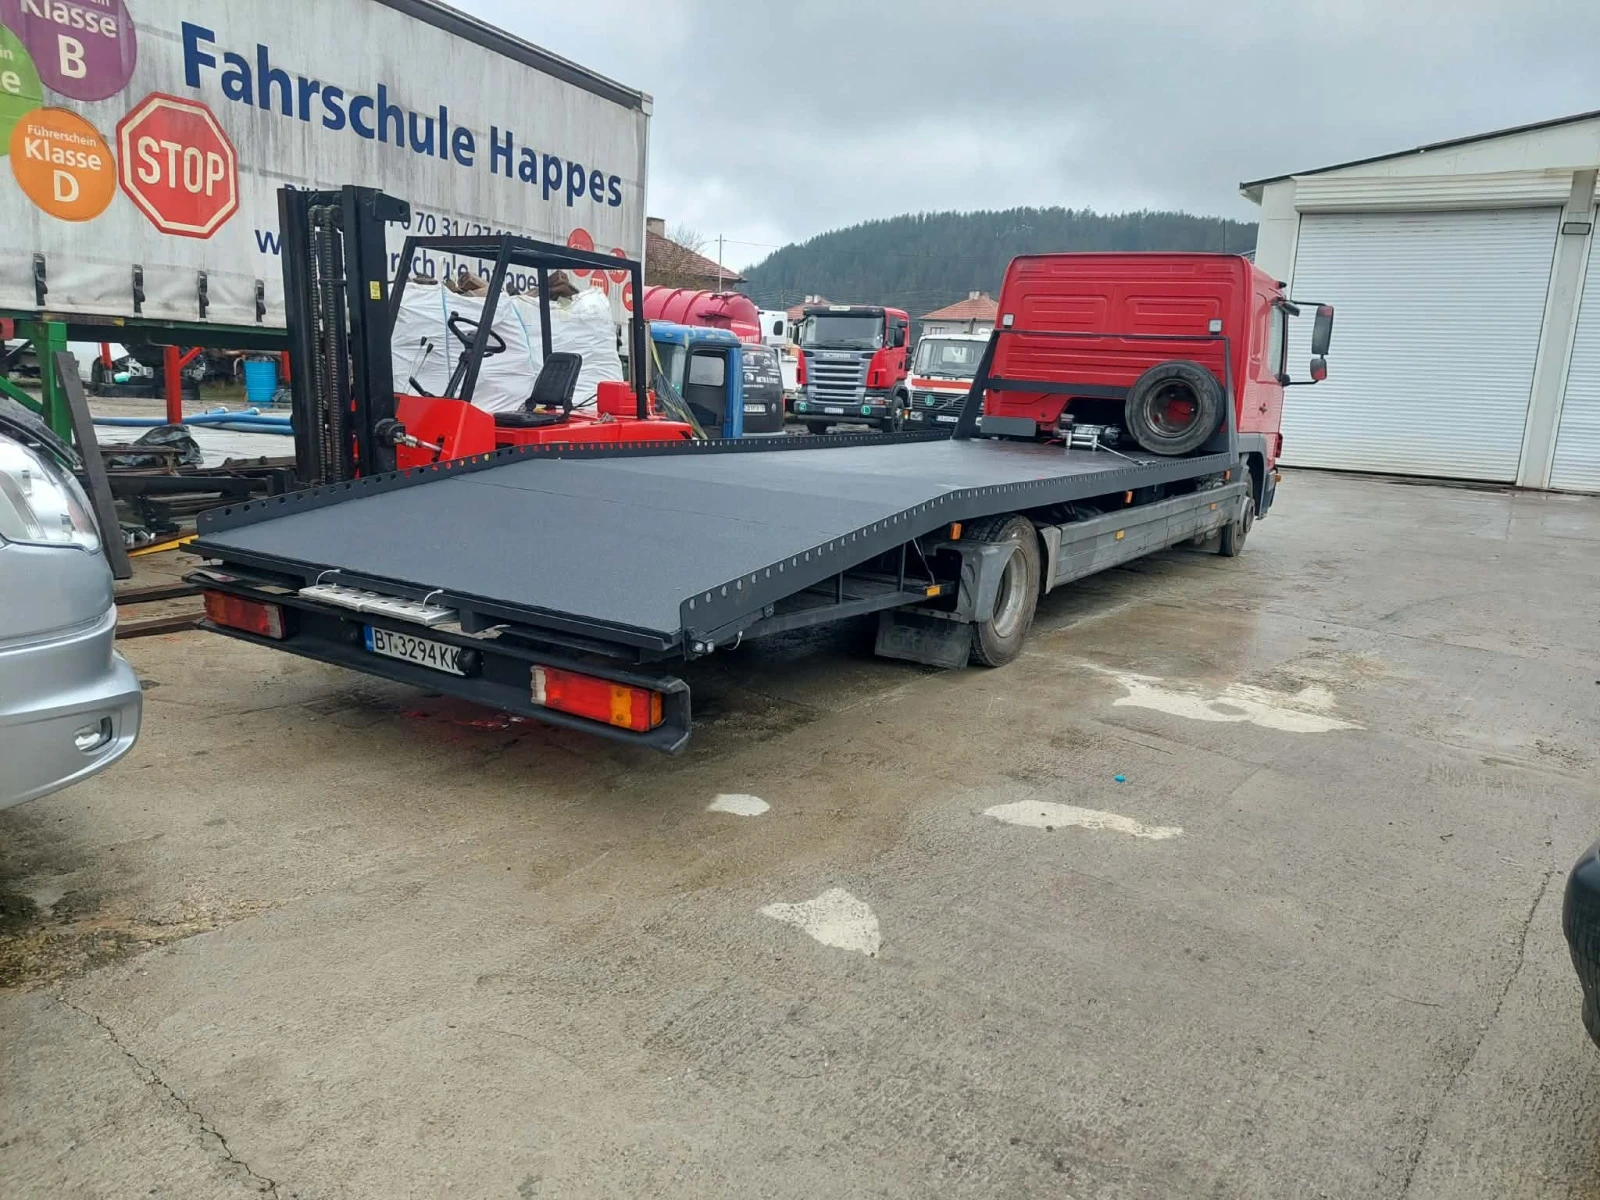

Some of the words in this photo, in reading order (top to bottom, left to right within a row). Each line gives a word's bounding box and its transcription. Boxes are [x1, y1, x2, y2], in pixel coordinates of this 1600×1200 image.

[57, 33, 87, 79] B
[181, 21, 476, 167] Fahrschule
[489, 125, 622, 207] Happes
[24, 137, 101, 170] Klasse
[27, 124, 97, 147] Führerschein
[137, 136, 225, 197] STOP
[53, 169, 79, 203] D
[415, 211, 436, 235] 70
[374, 629, 394, 653] BT
[398, 635, 437, 665] 3294
[439, 646, 461, 671] KK
